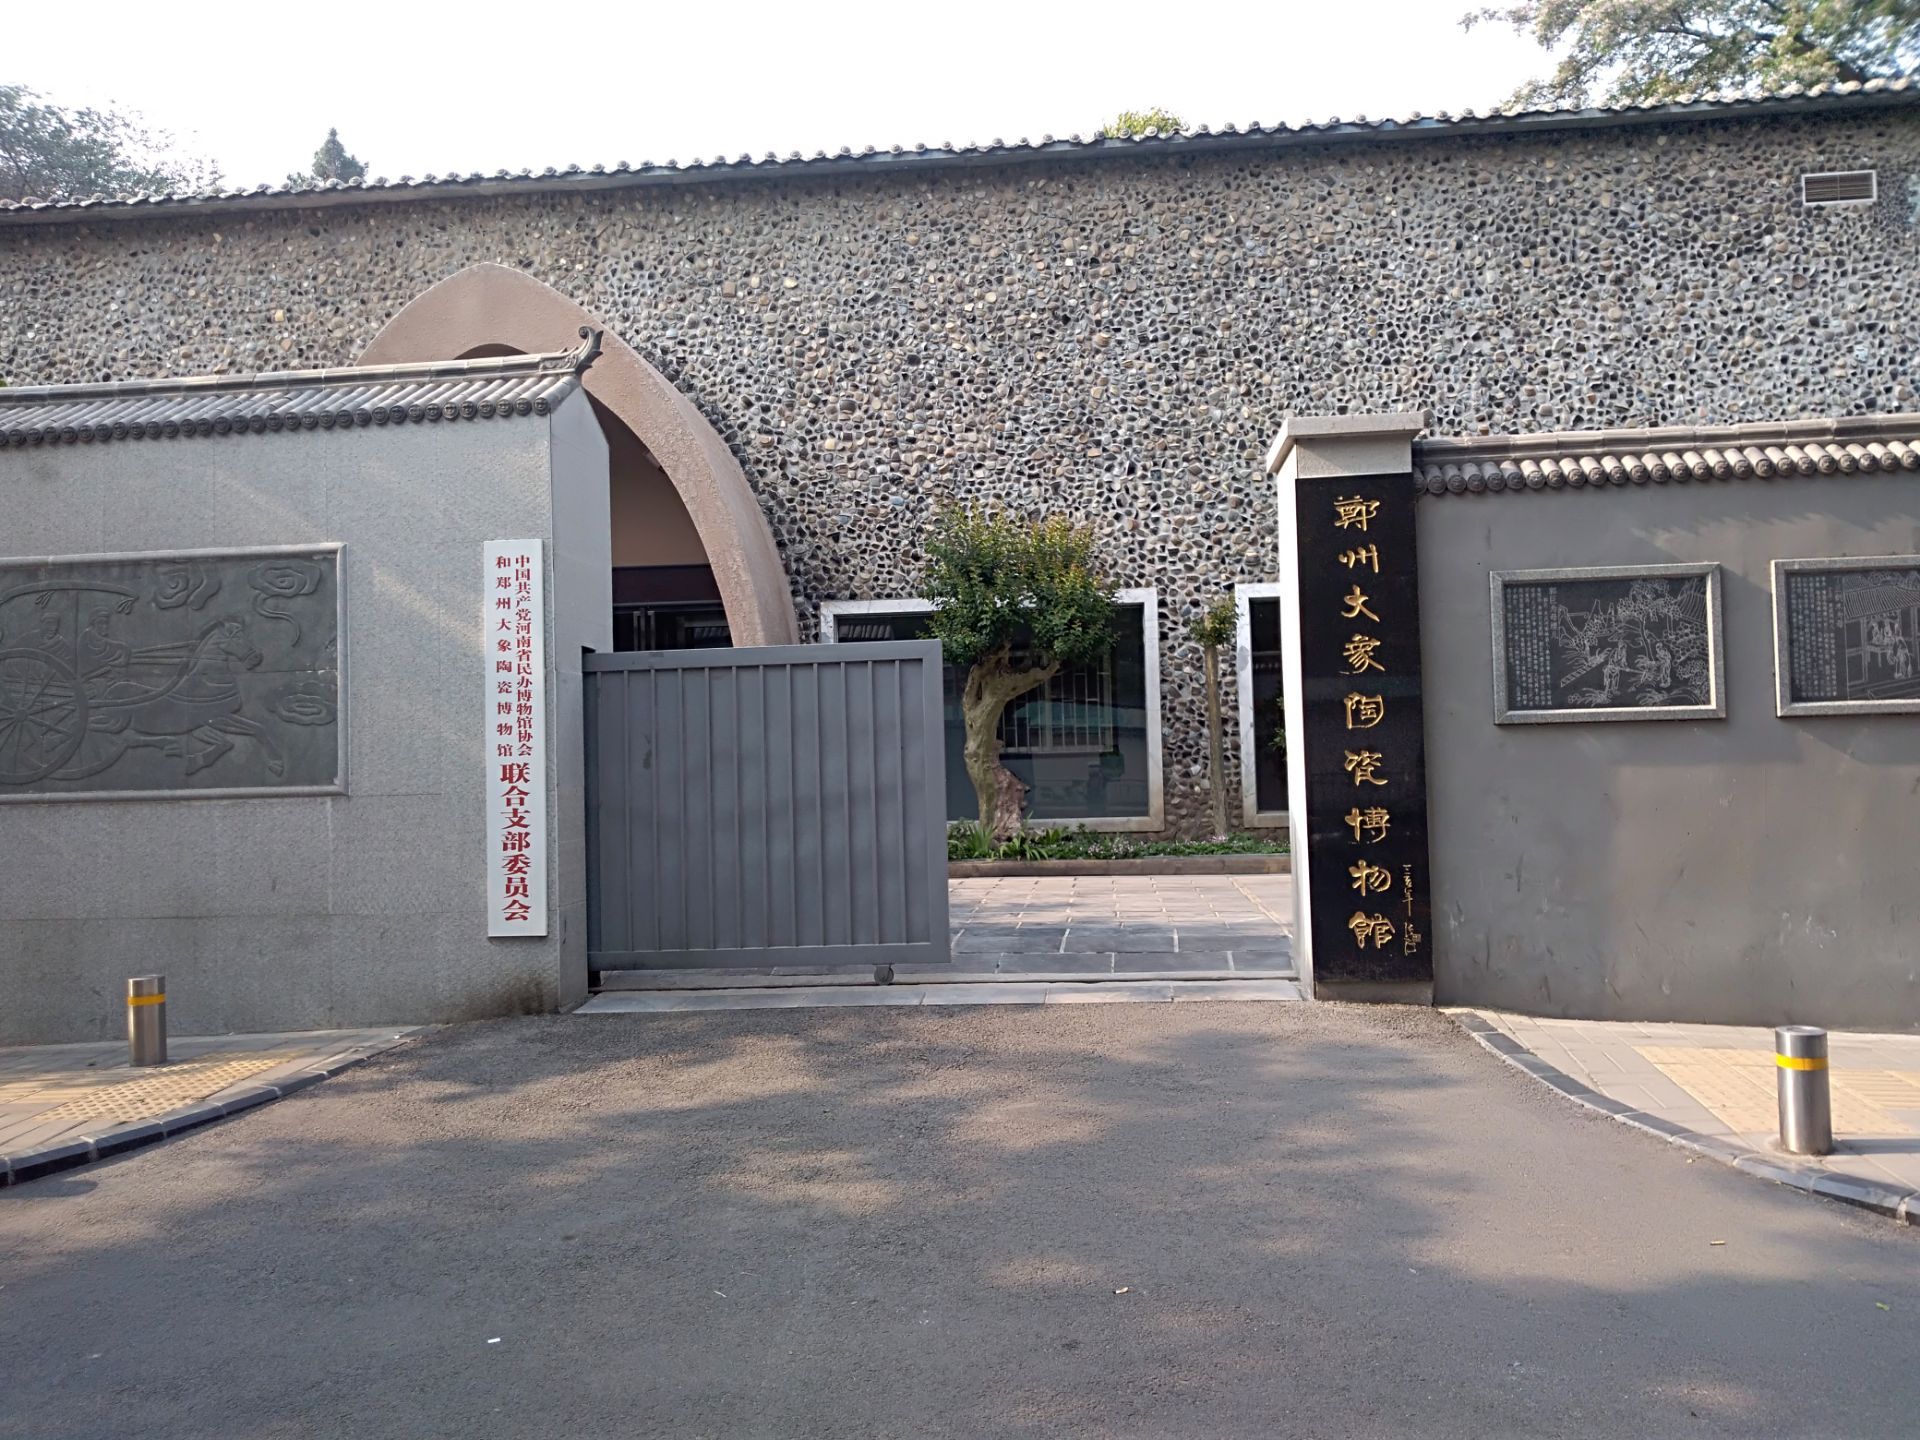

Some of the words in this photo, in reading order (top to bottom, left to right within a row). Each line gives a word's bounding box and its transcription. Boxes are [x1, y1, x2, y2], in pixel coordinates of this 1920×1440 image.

[495, 555, 513, 757] 和郑州大象陶瓷博物馆
[514, 555, 533, 757] 中国共产党河南省民办博物馆协会
[499, 762, 532, 922] 联合支部委员会
